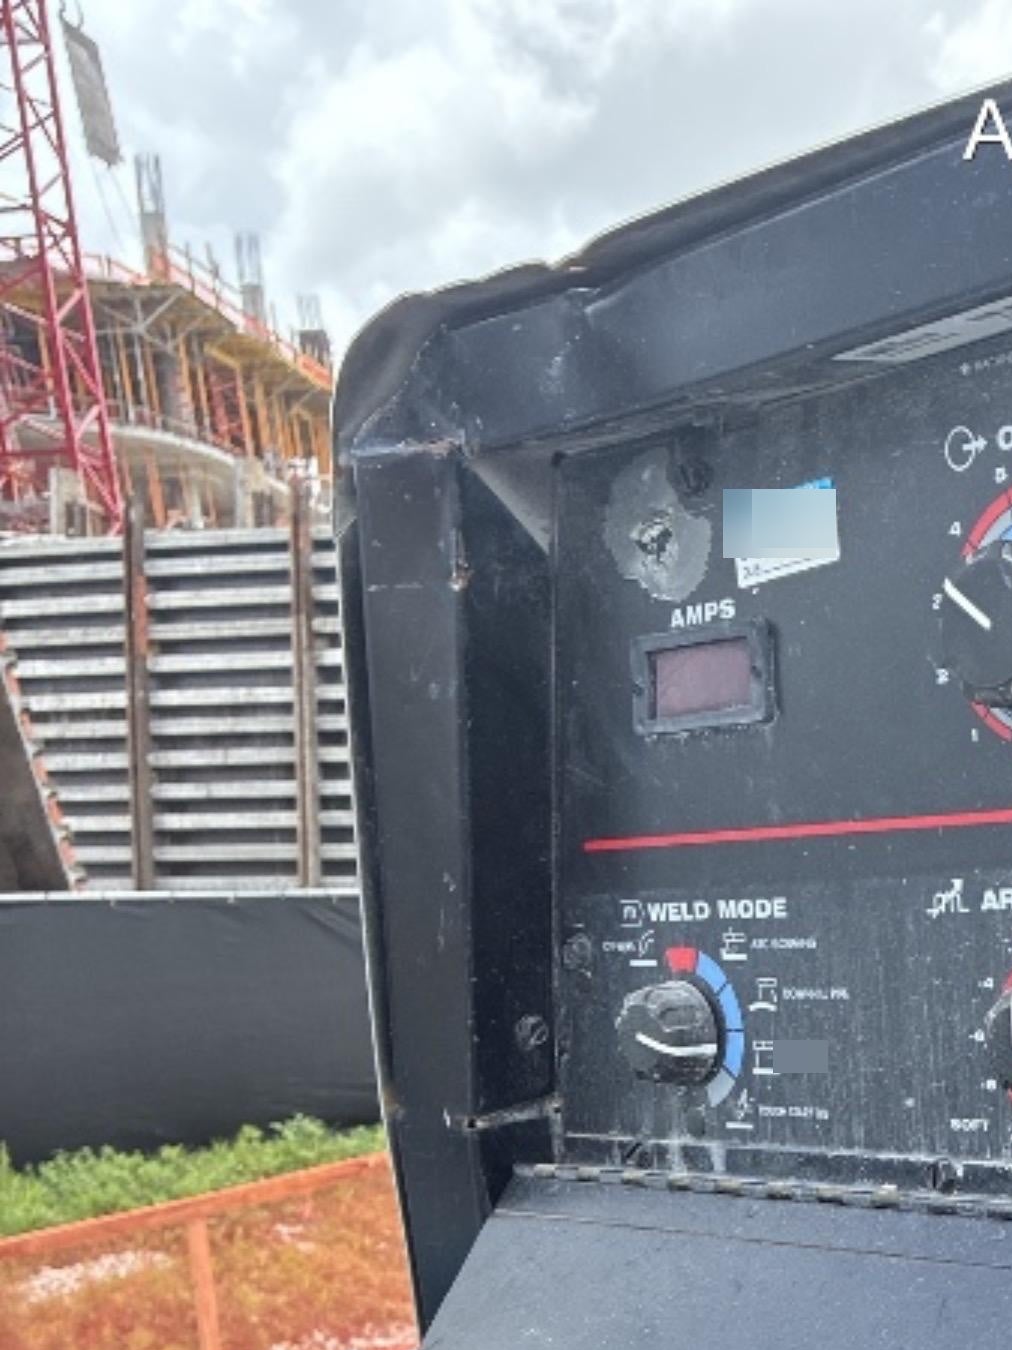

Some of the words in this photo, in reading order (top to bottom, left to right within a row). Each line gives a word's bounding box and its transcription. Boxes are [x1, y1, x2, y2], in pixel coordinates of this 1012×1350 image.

[670, 598, 736, 629] AMPS
[647, 901, 711, 922] WELD
[717, 897, 788, 919] MODE
